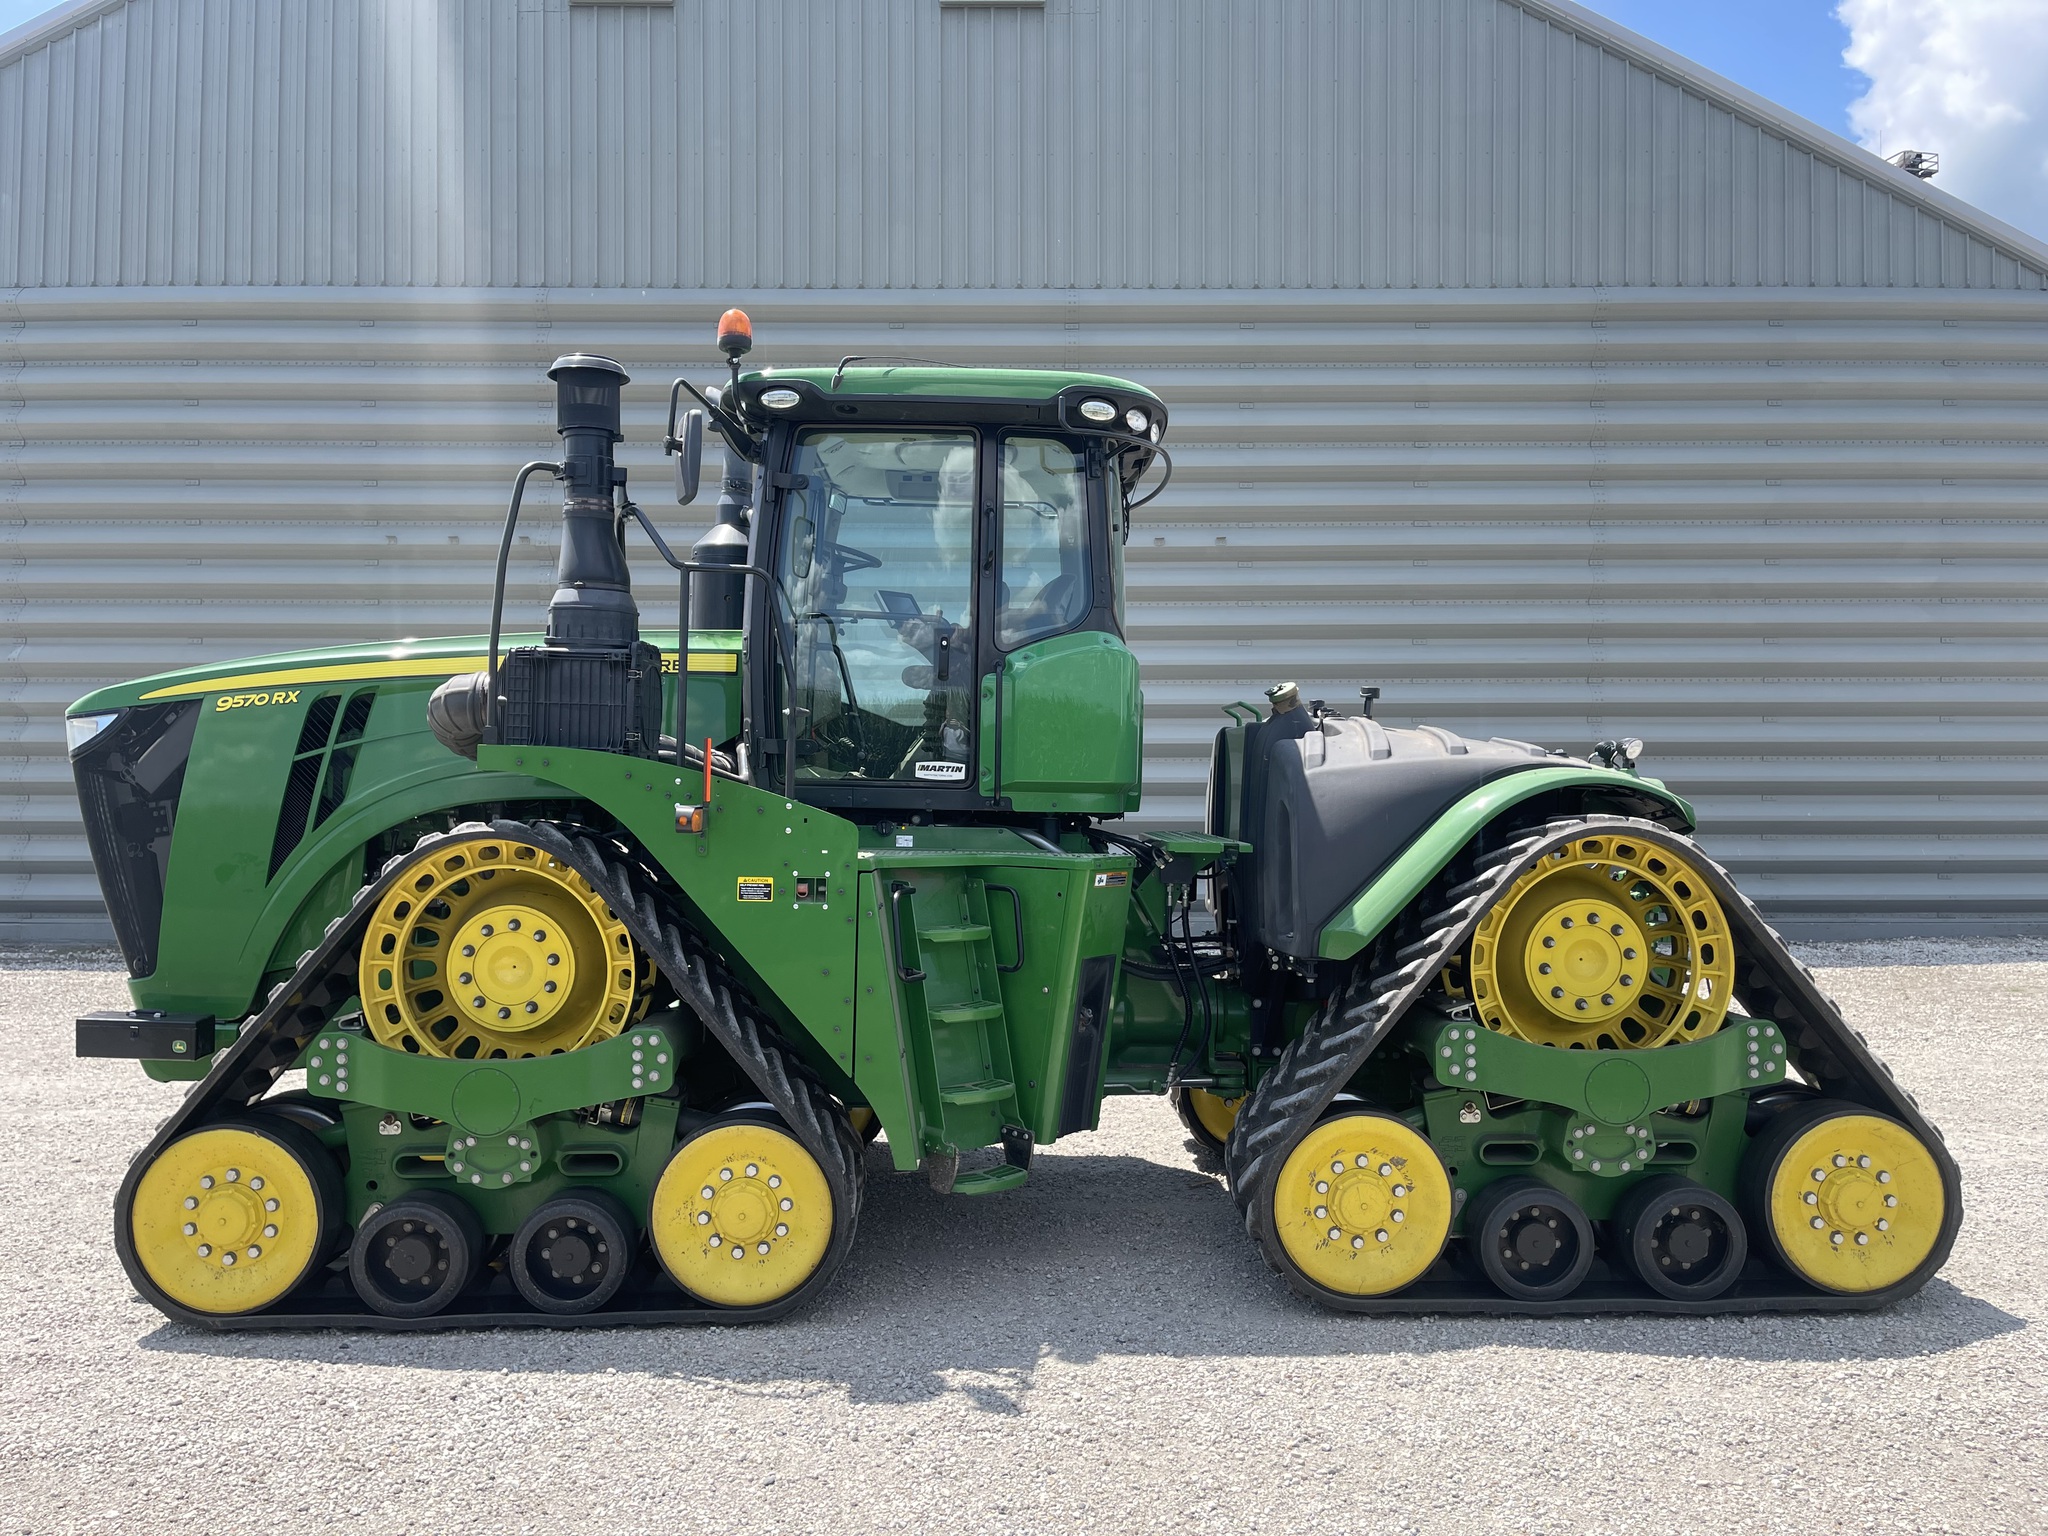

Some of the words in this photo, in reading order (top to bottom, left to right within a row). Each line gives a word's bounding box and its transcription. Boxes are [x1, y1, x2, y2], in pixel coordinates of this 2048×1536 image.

[215, 693, 270, 712] 9570
[271, 690, 302, 704] RX
[918, 764, 963, 773] MARTIN
